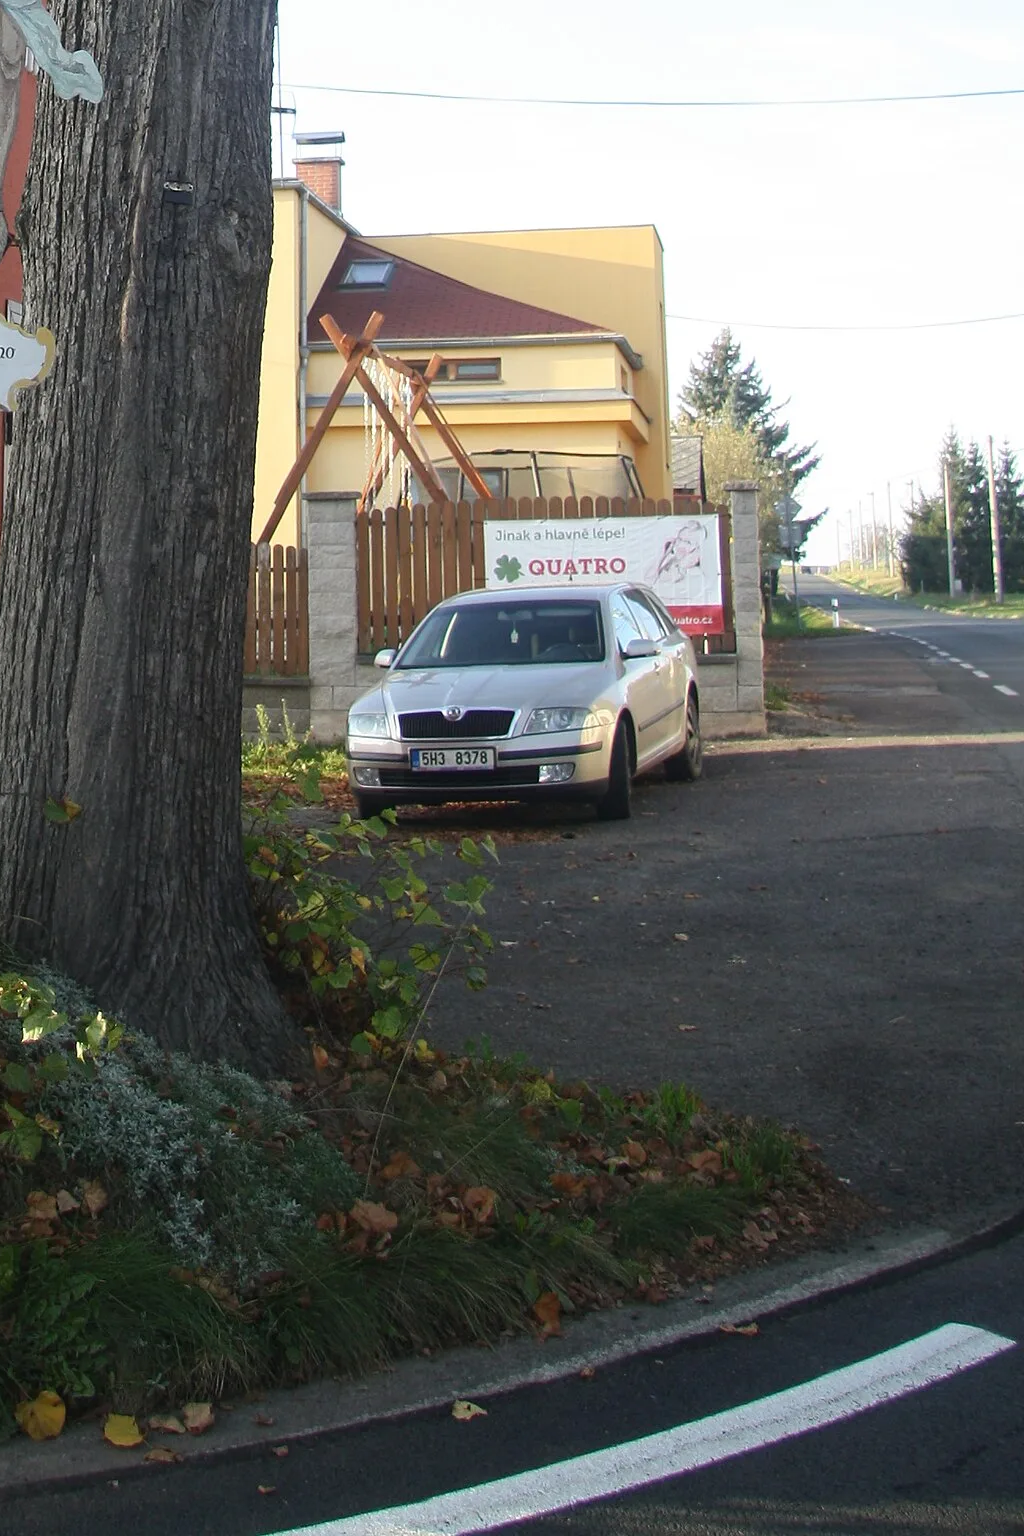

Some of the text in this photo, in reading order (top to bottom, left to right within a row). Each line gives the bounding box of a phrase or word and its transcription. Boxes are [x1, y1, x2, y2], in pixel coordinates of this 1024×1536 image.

[495, 526, 626, 542] Jinak a hlavně lépe!
[528, 557, 626, 576] QUATRO
[673, 615, 713, 626] uatro.cz
[421, 751, 446, 766] 5H3
[455, 750, 488, 765] 8378
